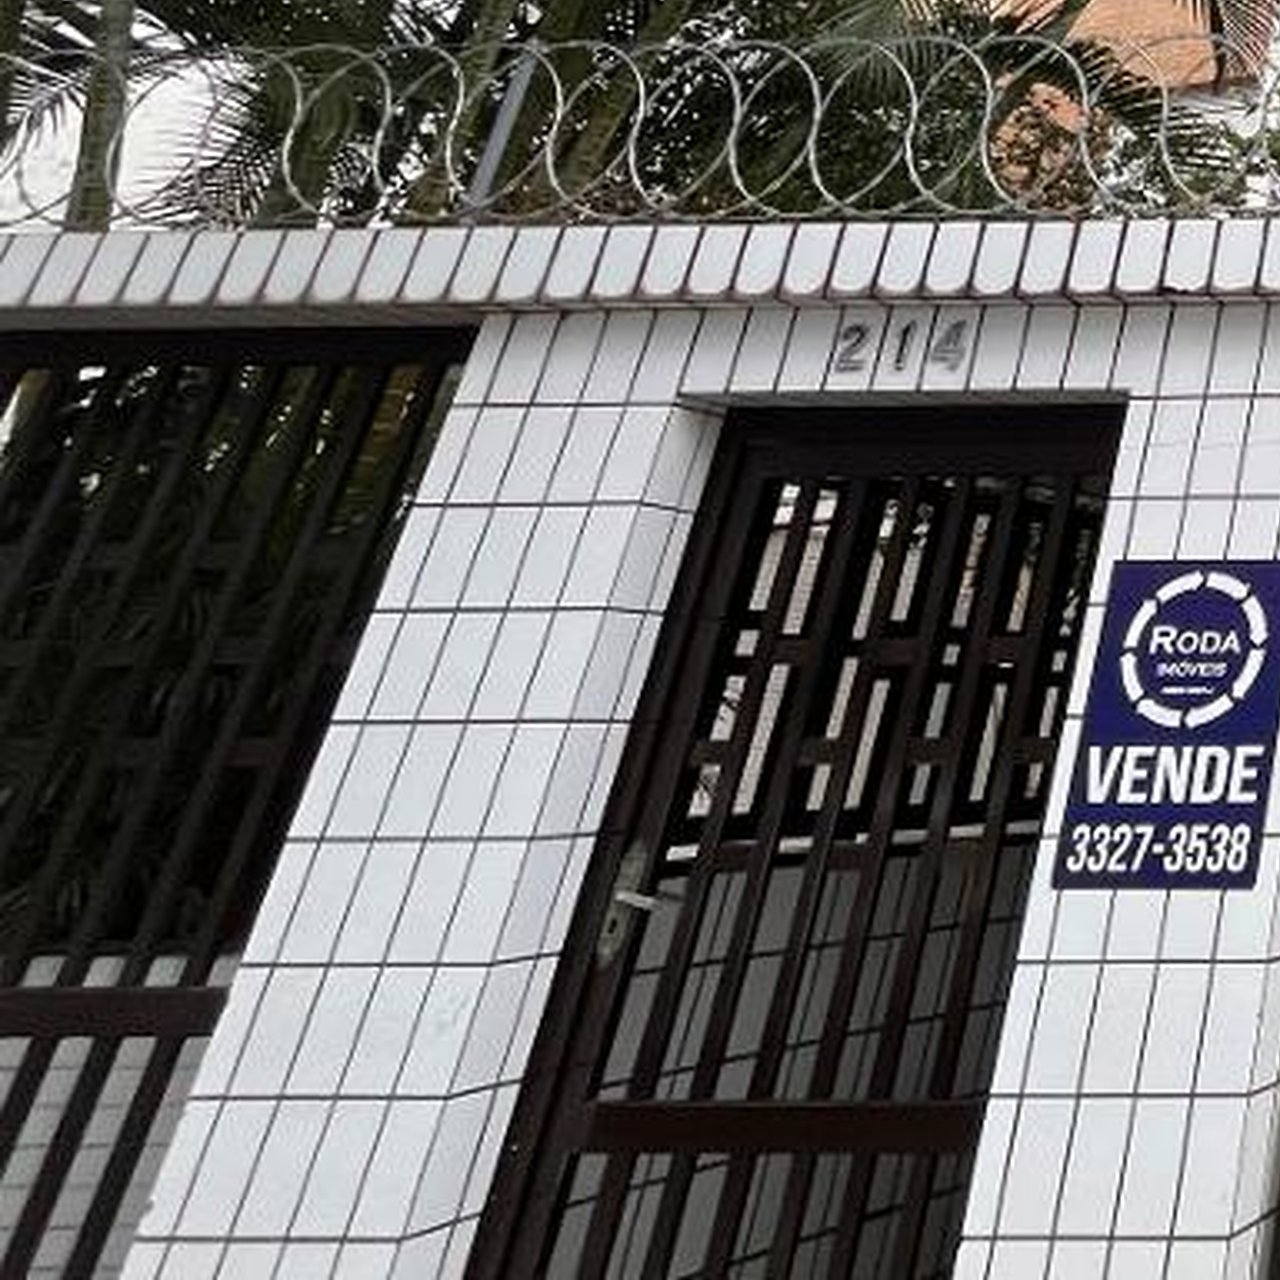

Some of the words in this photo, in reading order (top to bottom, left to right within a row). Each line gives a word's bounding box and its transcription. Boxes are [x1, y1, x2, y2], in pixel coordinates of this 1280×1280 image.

[835, 320, 967, 372] 214
[1086, 745, 1265, 805] VENDE
[1066, 823, 1252, 872] 3327-3538
